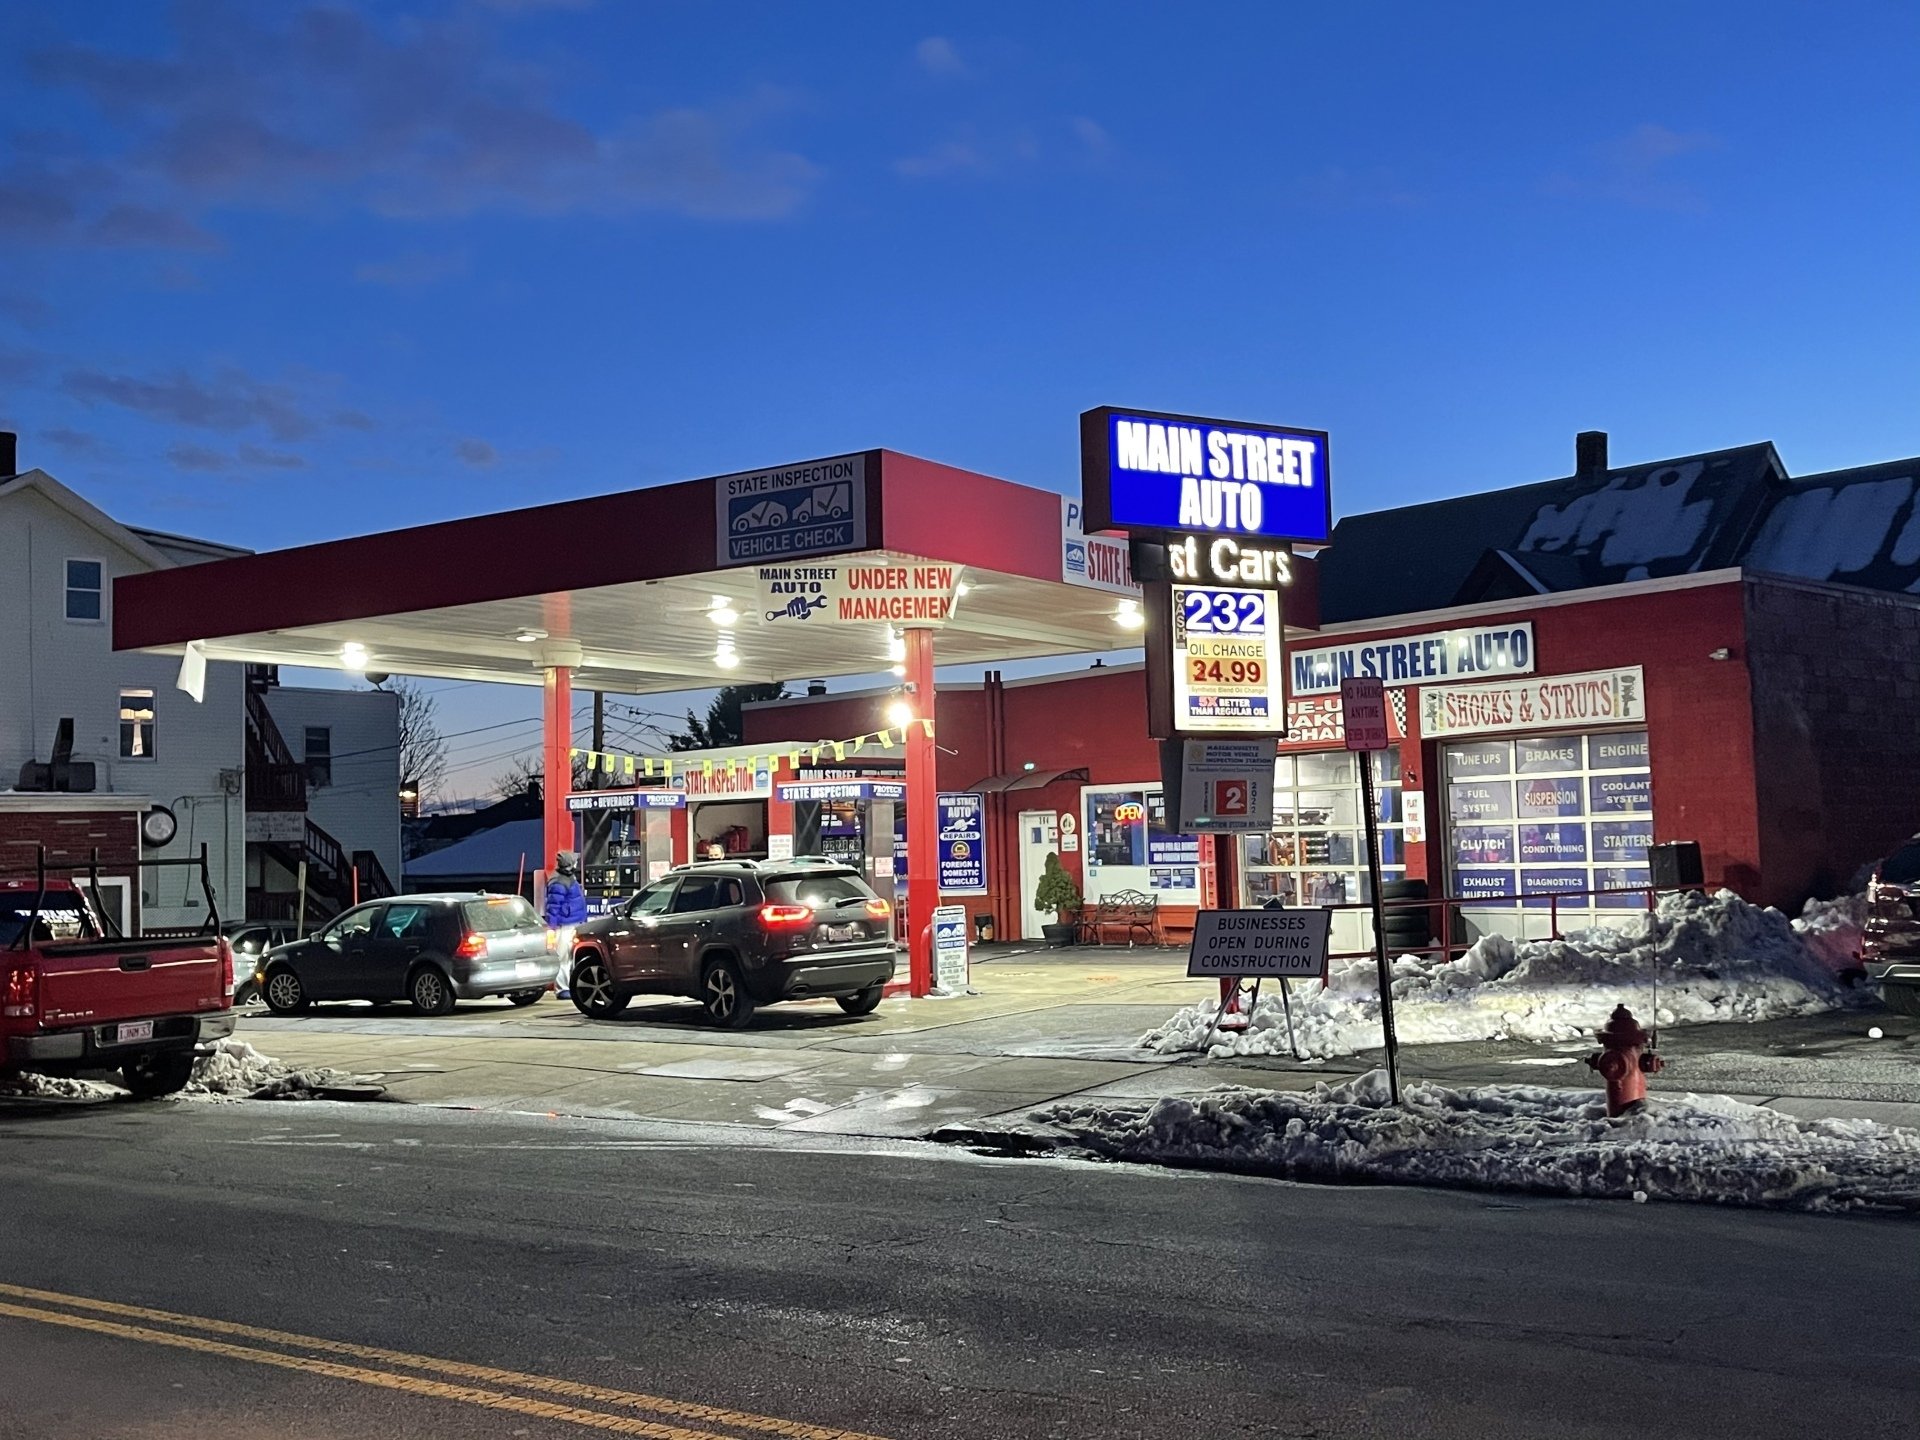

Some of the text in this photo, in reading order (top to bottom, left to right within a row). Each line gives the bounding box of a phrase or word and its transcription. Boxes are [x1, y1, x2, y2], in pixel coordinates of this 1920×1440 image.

[1117, 420, 1315, 487] MAIN STREET
[728, 461, 853, 495] STATE INSPECTION
[1179, 477, 1262, 531] AUTO
[731, 526, 845, 557] VEHICLE CHECK
[1087, 540, 1121, 586] STATE
[1210, 538, 1292, 582] Cars
[759, 568, 838, 580] MAIN STREET
[848, 567, 952, 591] UNDER NEW
[770, 582, 822, 594] AUTO
[838, 596, 954, 620] MANAGEMEN
[1185, 592, 1265, 632] 232
[1175, 591, 1186, 640] CASH
[1189, 643, 1264, 657] OIL CHANGE
[1295, 629, 1529, 690] MAIN STREET AUTO
[1192, 659, 1261, 683] 24.99
[1198, 696, 1251, 708] 5X BETTER
[1446, 680, 1612, 728] SHOCKS & STRUTS
[1191, 707, 1267, 716] THAN REGULAR OIL
[1525, 748, 1574, 762] BRAKES
[1600, 743, 1649, 758] ENGINE
[1457, 753, 1501, 766] TUNE UPS
[685, 768, 707, 795] STATE
[799, 769, 824, 780] MAIN
[782, 785, 861, 799] STATE INSPECTION
[1601, 781, 1651, 791] COOLANT
[1226, 786, 1242, 809] 2
[1467, 790, 1490, 799] FUEL
[1524, 790, 1577, 806] SUSPENSION
[1606, 794, 1648, 804] SYSTEM
[569, 796, 635, 810] CIGARS BEVERAGES
[1462, 803, 1499, 813] SYSTEM
[948, 807, 971, 818] AUTO
[1115, 806, 1143, 821] OPEN
[1545, 832, 1560, 840] AIR
[1603, 834, 1654, 848] STARTERS
[1460, 839, 1506, 850] CLUTCH
[1522, 844, 1585, 854] CONDITIONING
[974, 860, 980, 868] &
[943, 869, 980, 877] DOMESTIC
[1463, 878, 1506, 887] EXHAUST
[1527, 878, 1583, 886] DIAGNOSTICS
[1218, 917, 1306, 930] BUSINESSES
[1208, 936, 1310, 949] OPEN DURING
[1201, 955, 1312, 968] CONSTRUCTION
